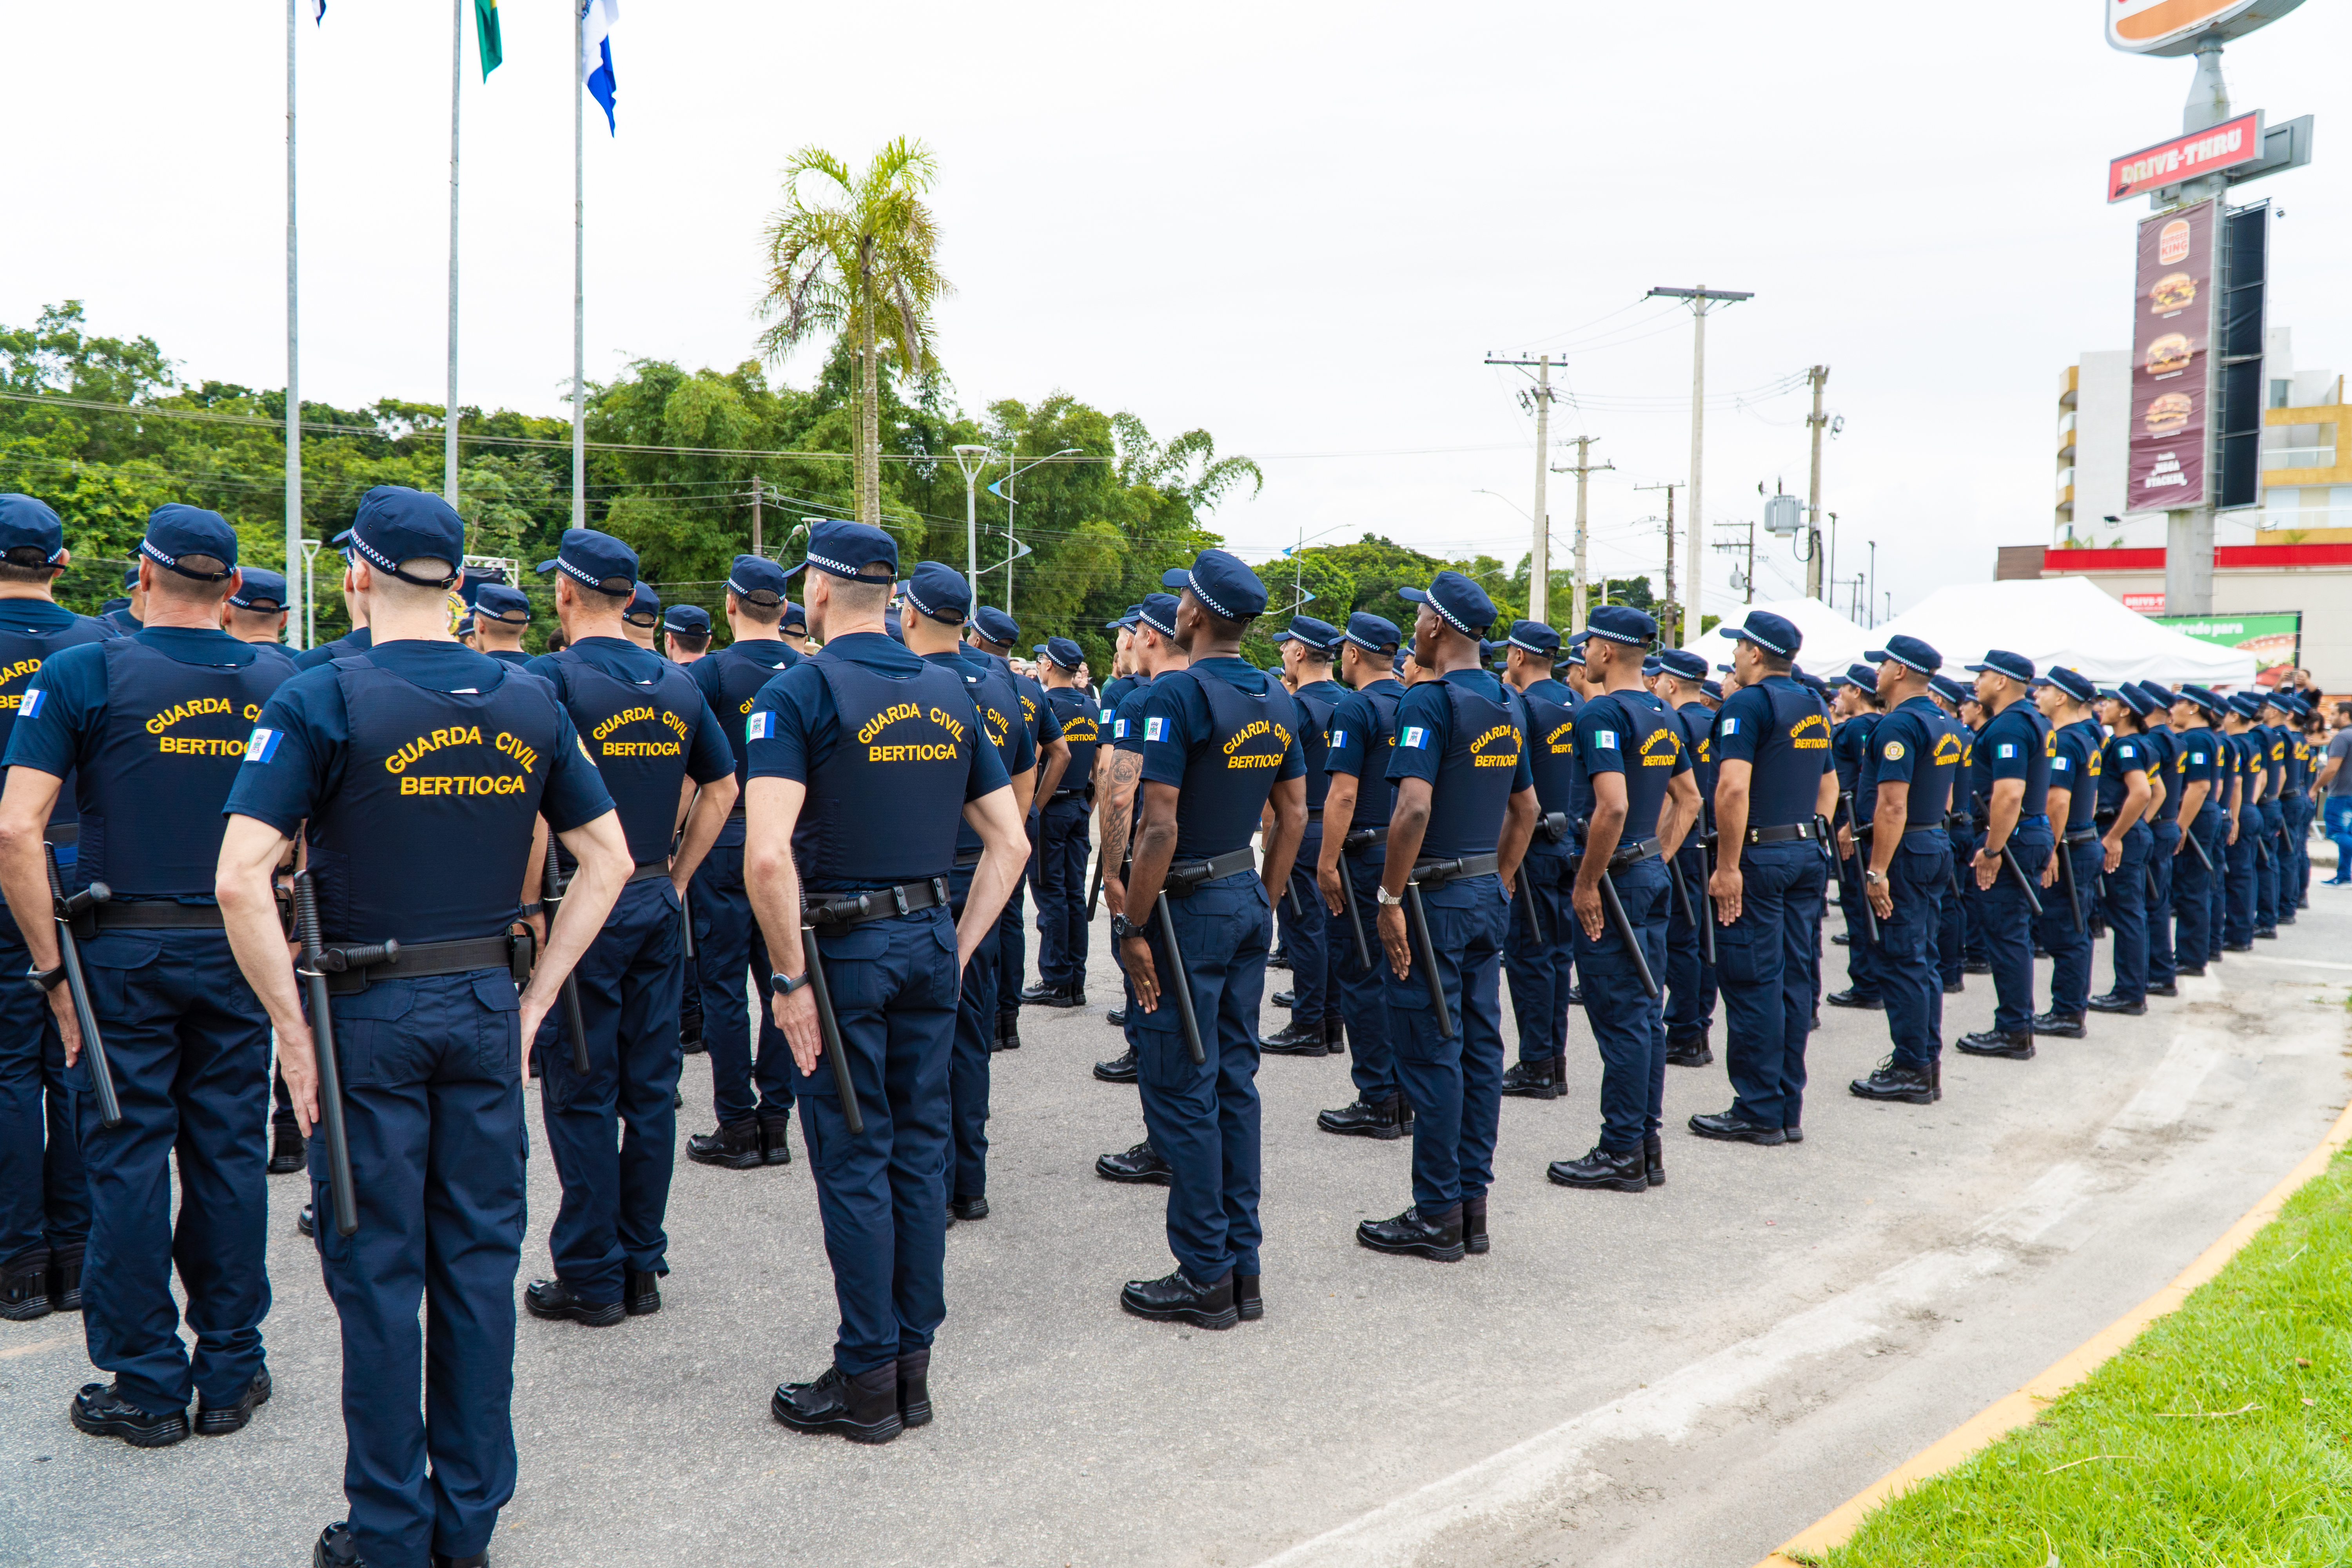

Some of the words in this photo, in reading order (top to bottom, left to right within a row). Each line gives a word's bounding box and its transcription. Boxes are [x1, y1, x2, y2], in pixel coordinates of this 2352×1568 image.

[2121, 127, 2242, 184] DRIVE-THRU
[2162, 240, 2188, 256] KING
[2125, 596, 2165, 606] DRIVE-T
[2212, 622, 2243, 637] para
[0, 659, 42, 686] ARD
[1020, 695, 1036, 713] CIVIL
[146, 698, 232, 734] GUARDA
[593, 707, 655, 740] GUARDA
[662, 711, 688, 740] CIVIL
[858, 702, 921, 744] GUARDA
[930, 707, 964, 742] CIVIL
[987, 708, 1009, 734] CIVIL
[1546, 722, 1572, 744] GUARD
[1790, 715, 1822, 738] GUARDA
[160, 737, 249, 756] BERTIO
[1065, 733, 1097, 742] BERTIOGA
[1223, 720, 1270, 754] GUARDA
[1274, 723, 1292, 751] CIVIL
[1470, 724, 1511, 754] GUARDA
[1640, 728, 1668, 755] GUARDA
[1794, 738, 1828, 749] BERTIOGA
[385, 726, 482, 773] GUARDA
[495, 732, 537, 773] CIVIL
[603, 742, 681, 757] BERTIOGA
[869, 743, 957, 762] BERTIOGA
[1552, 744, 1572, 753] BERT
[1227, 753, 1283, 768] BERTIOGA
[1474, 754, 1518, 767] BERTIOGA
[1643, 754, 1676, 766] BERTIOGA
[401, 775, 525, 795] BERTIOGA
